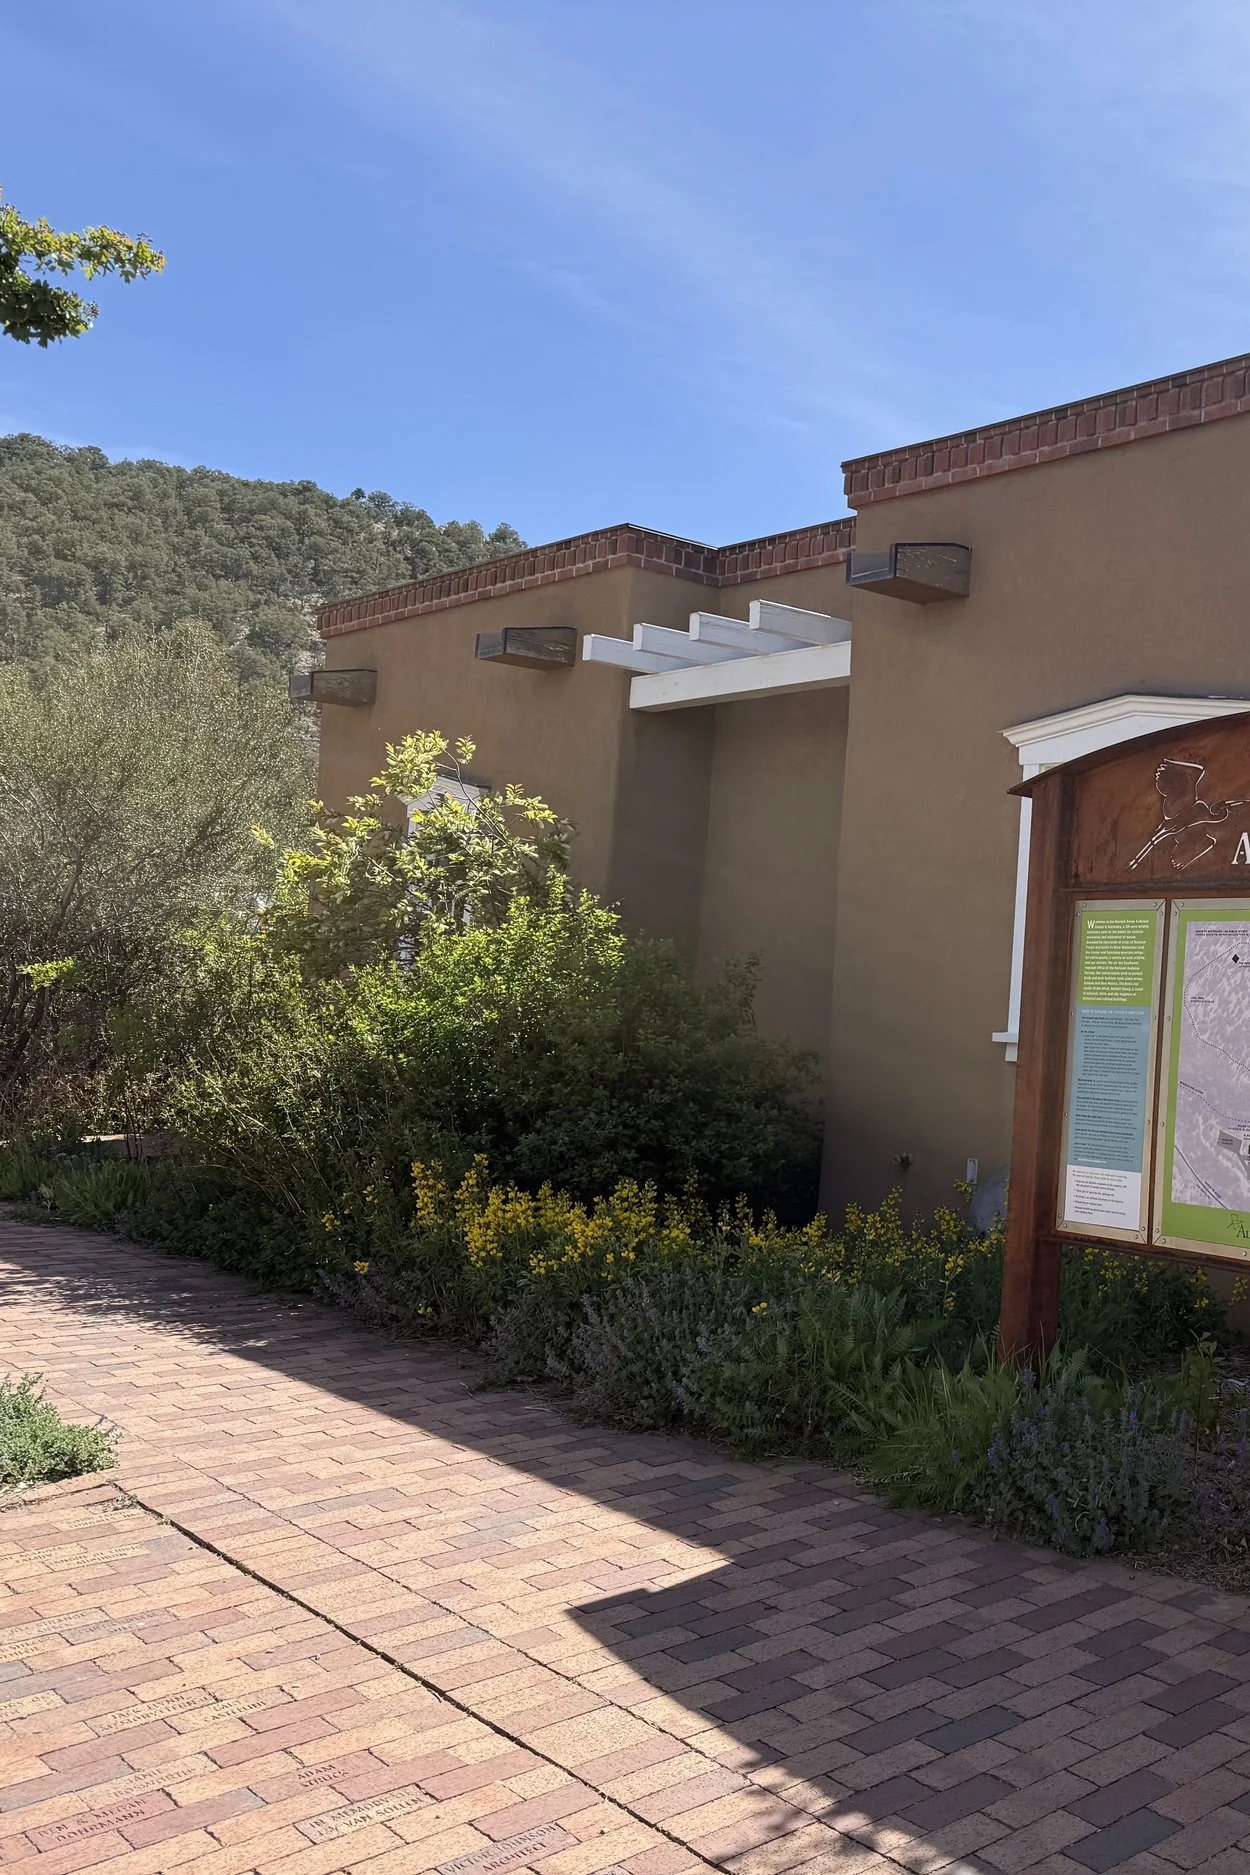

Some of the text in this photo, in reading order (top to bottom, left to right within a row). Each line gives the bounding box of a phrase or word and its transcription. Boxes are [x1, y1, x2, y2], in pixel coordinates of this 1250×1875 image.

[295, 1764, 336, 1779] ADAM
[299, 1769, 349, 1788] STRUCK
[37, 1798, 146, 1837] BEN & MEGAN
[55, 1809, 145, 1842] DOHRMANN
[307, 1818, 327, 1828] IN
[328, 1797, 391, 1821] MEMORY
[342, 1814, 372, 1827] VAN
[374, 1797, 423, 1816] SOLLEN
[443, 1826, 557, 1872] VICTOR JOHNSON
[479, 1842, 548, 1871] ARCHITECT
